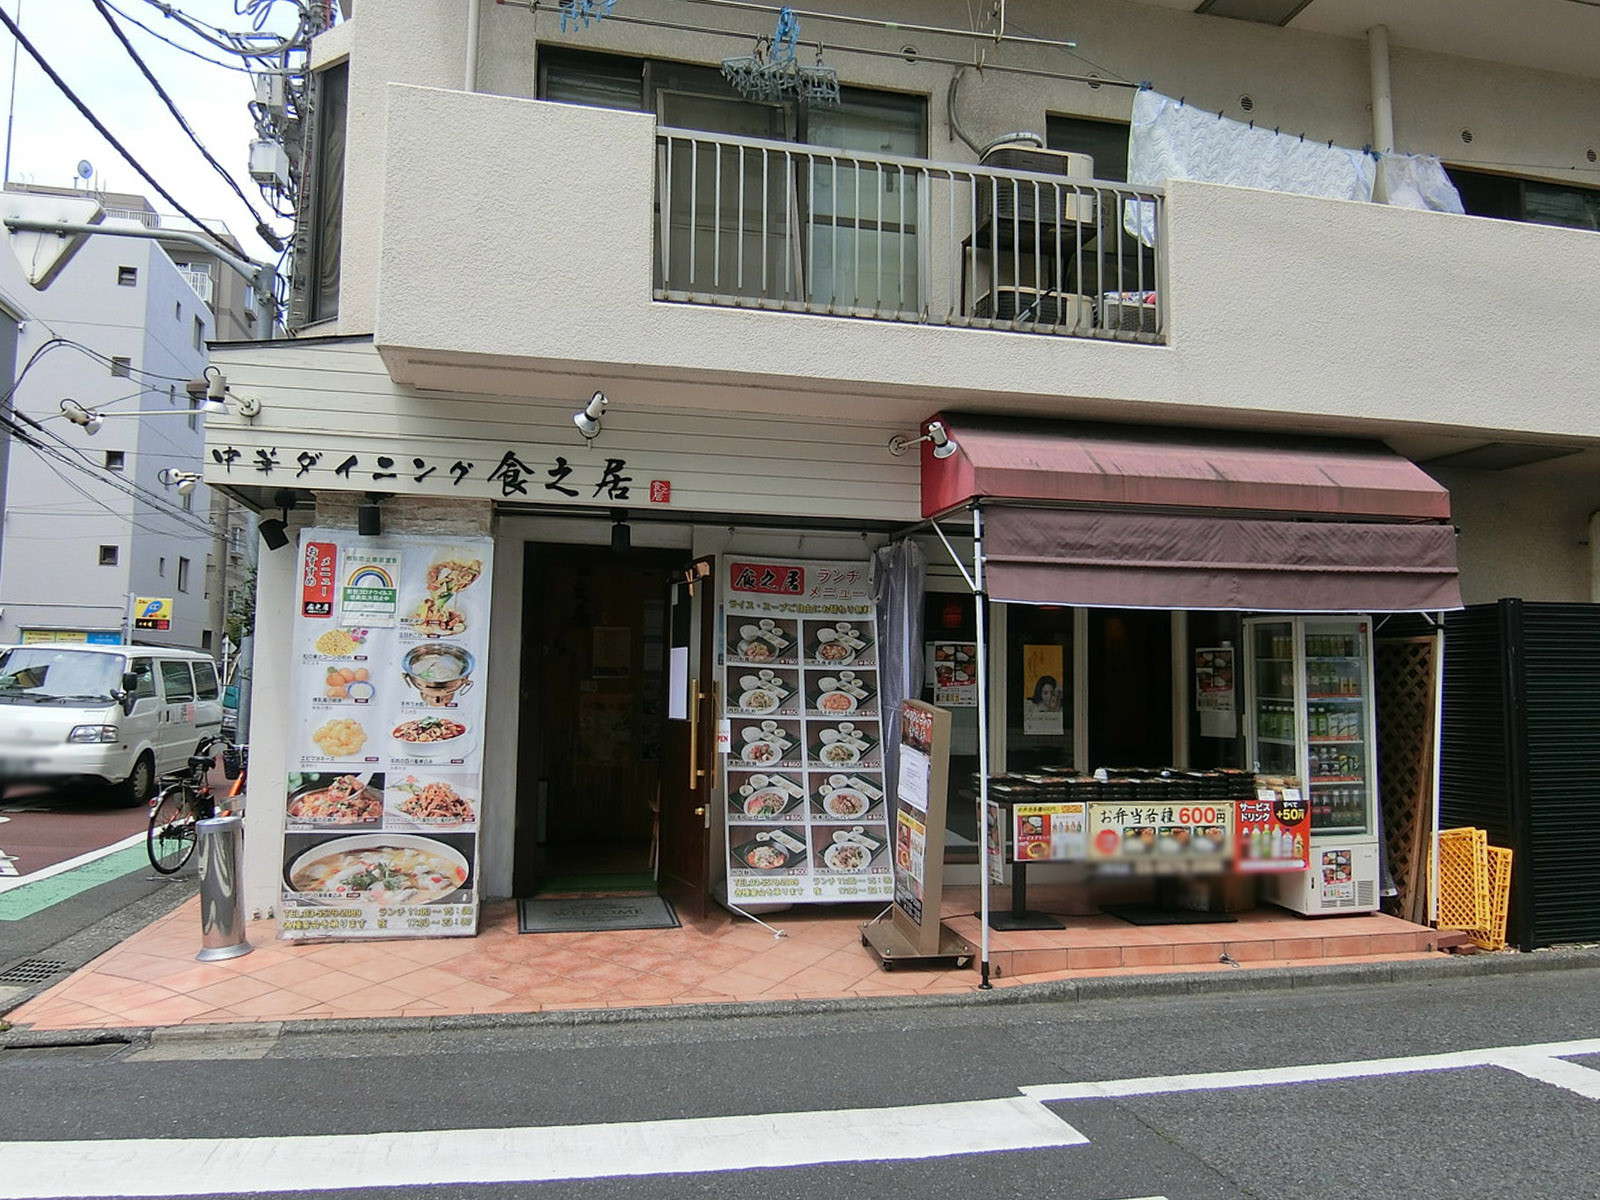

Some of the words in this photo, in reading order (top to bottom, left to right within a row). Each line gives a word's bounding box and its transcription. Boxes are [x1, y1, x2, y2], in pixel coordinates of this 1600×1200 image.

[305, 546, 319, 587] おすすめ
[320, 556, 332, 596] メニュー
[816, 569, 861, 585] ランチ
[809, 585, 867, 600] メニュー
[1239, 801, 1271, 812] サービス
[1100, 807, 1175, 825] お弁当各種
[1178, 805, 1226, 824] 600円
[1239, 812, 1271, 822] ドリンク
[553, 908, 644, 918] WELCOME
